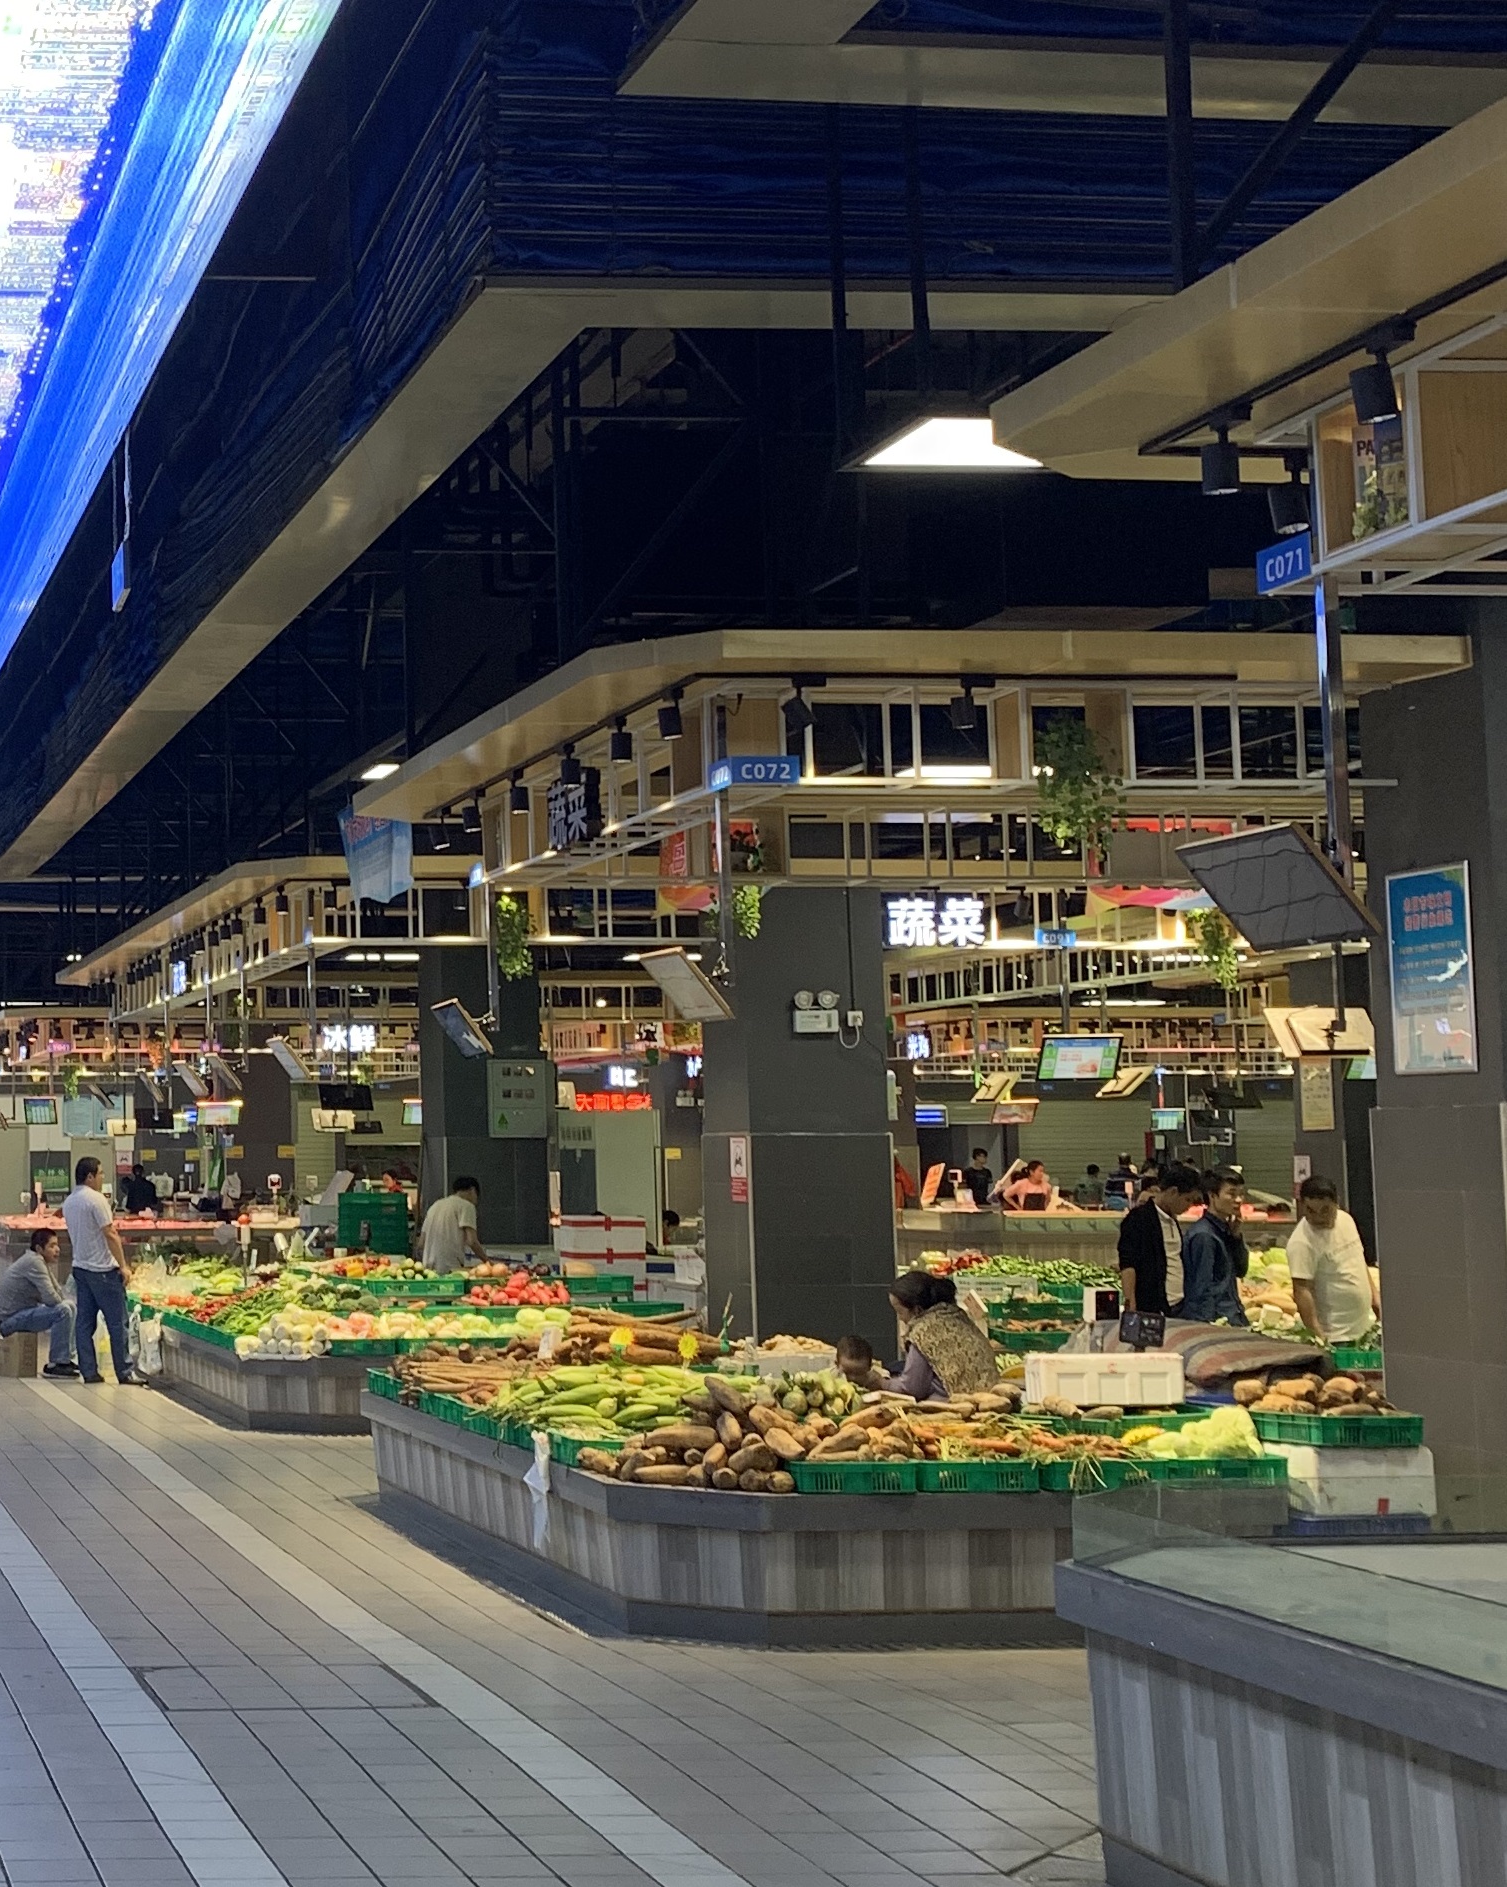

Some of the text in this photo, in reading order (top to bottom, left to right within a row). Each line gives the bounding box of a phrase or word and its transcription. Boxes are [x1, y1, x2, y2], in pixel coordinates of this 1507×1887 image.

[1265, 547, 1303, 582] C071
[741, 763, 792, 780] C072
[887, 898, 985, 947] 蔬菜
[322, 1024, 376, 1052] 冰鲜
